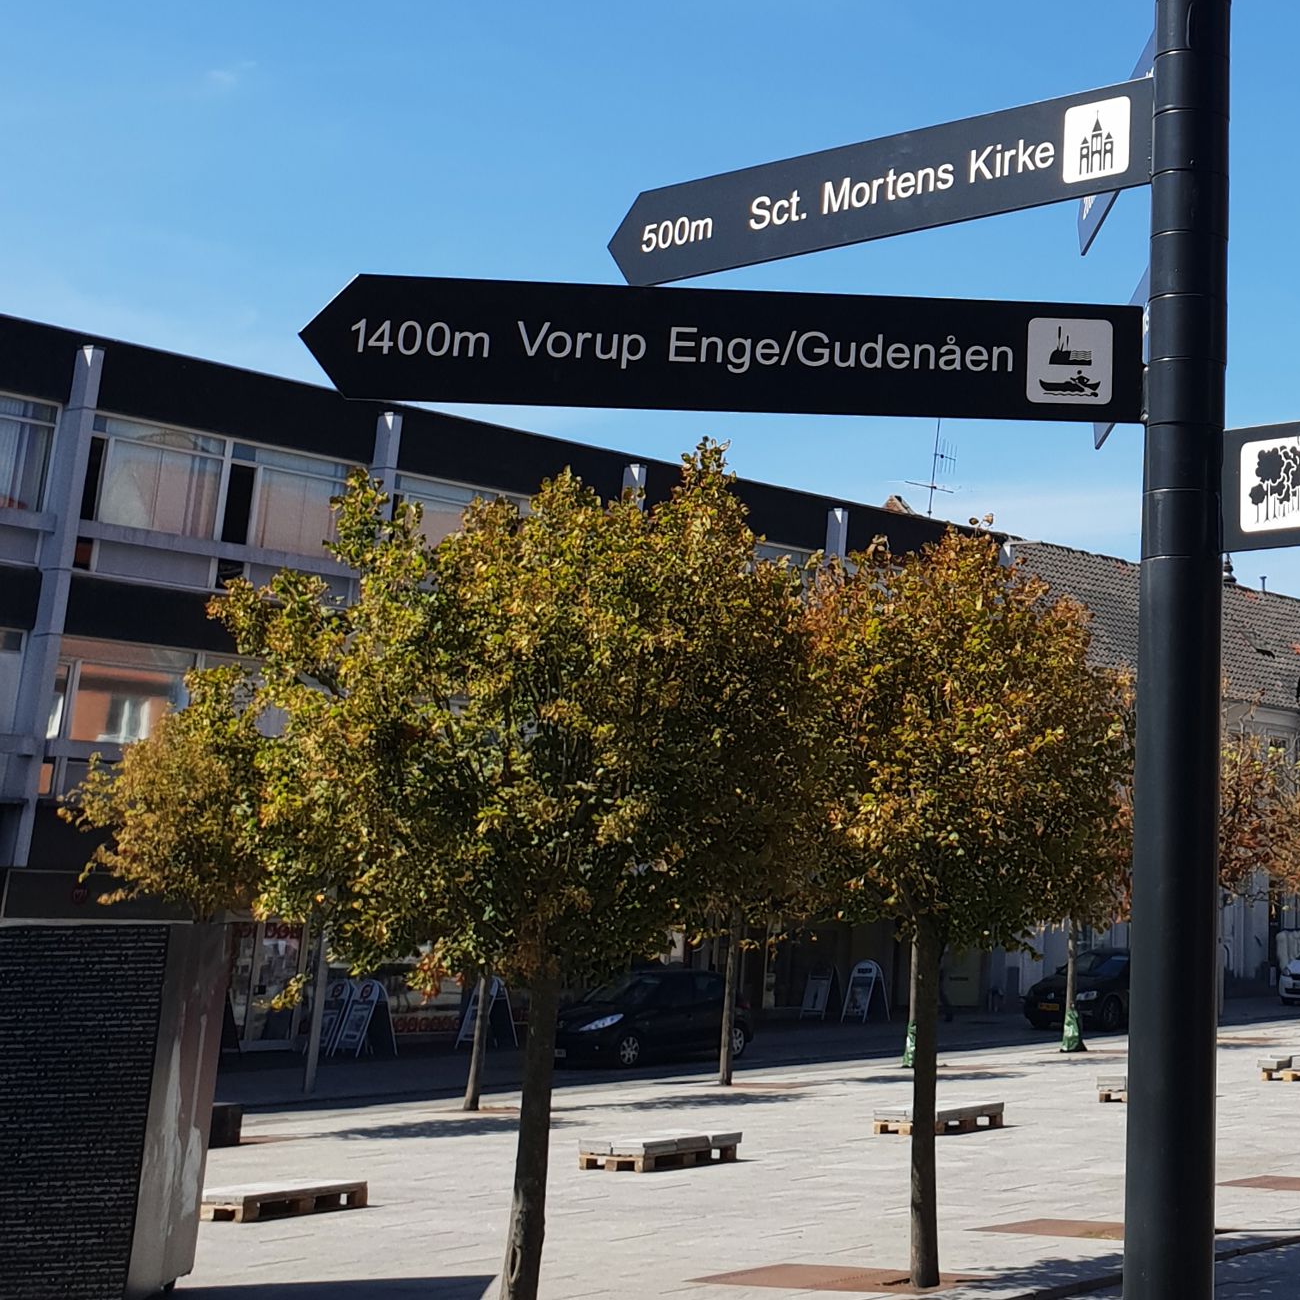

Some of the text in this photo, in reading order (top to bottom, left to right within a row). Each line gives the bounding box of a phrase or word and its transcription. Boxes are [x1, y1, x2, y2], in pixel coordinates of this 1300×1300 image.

[641, 138, 1055, 253] 500m Sct. Mortens Kirke
[351, 318, 1013, 374] 1400m Vorup Enge/Gudenåen
